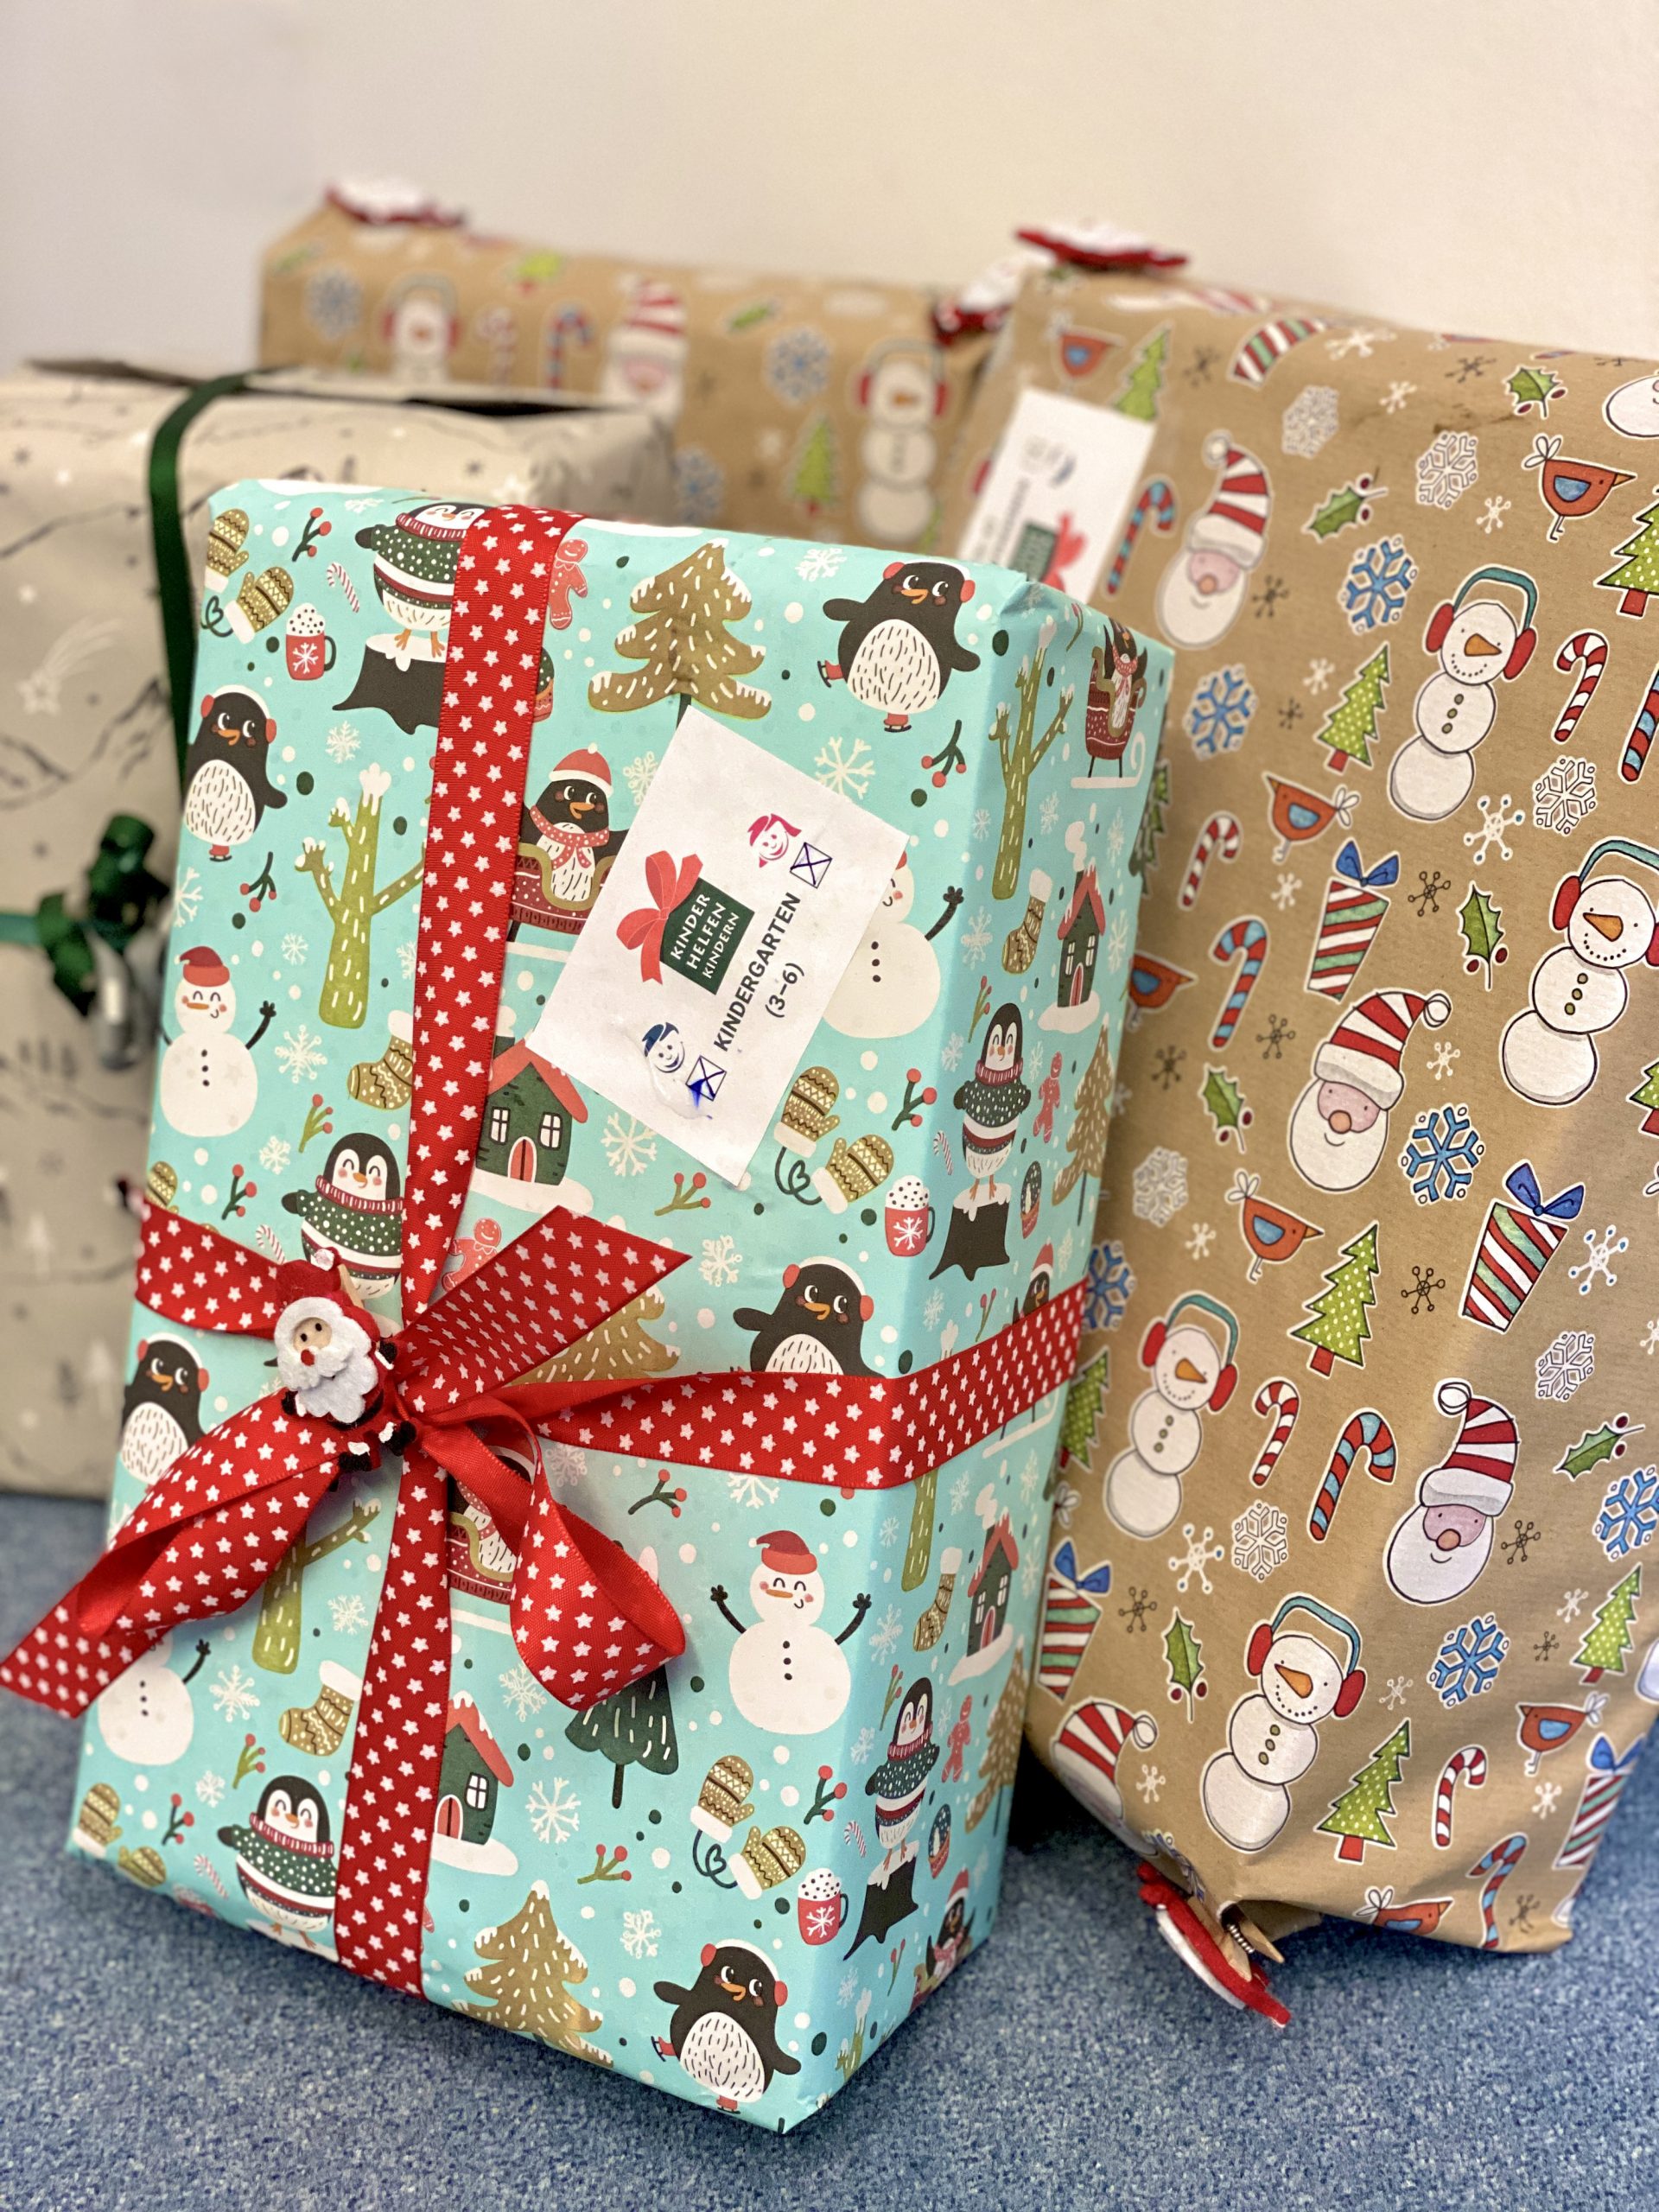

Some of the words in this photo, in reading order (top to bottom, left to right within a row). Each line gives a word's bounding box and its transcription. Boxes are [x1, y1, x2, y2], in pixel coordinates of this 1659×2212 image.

[671, 893, 710, 960] KINDER
[688, 902, 727, 969] HELFEN
[702, 912, 740, 979] KINDERN
[714, 893, 801, 1052] KINDERGARTEN
